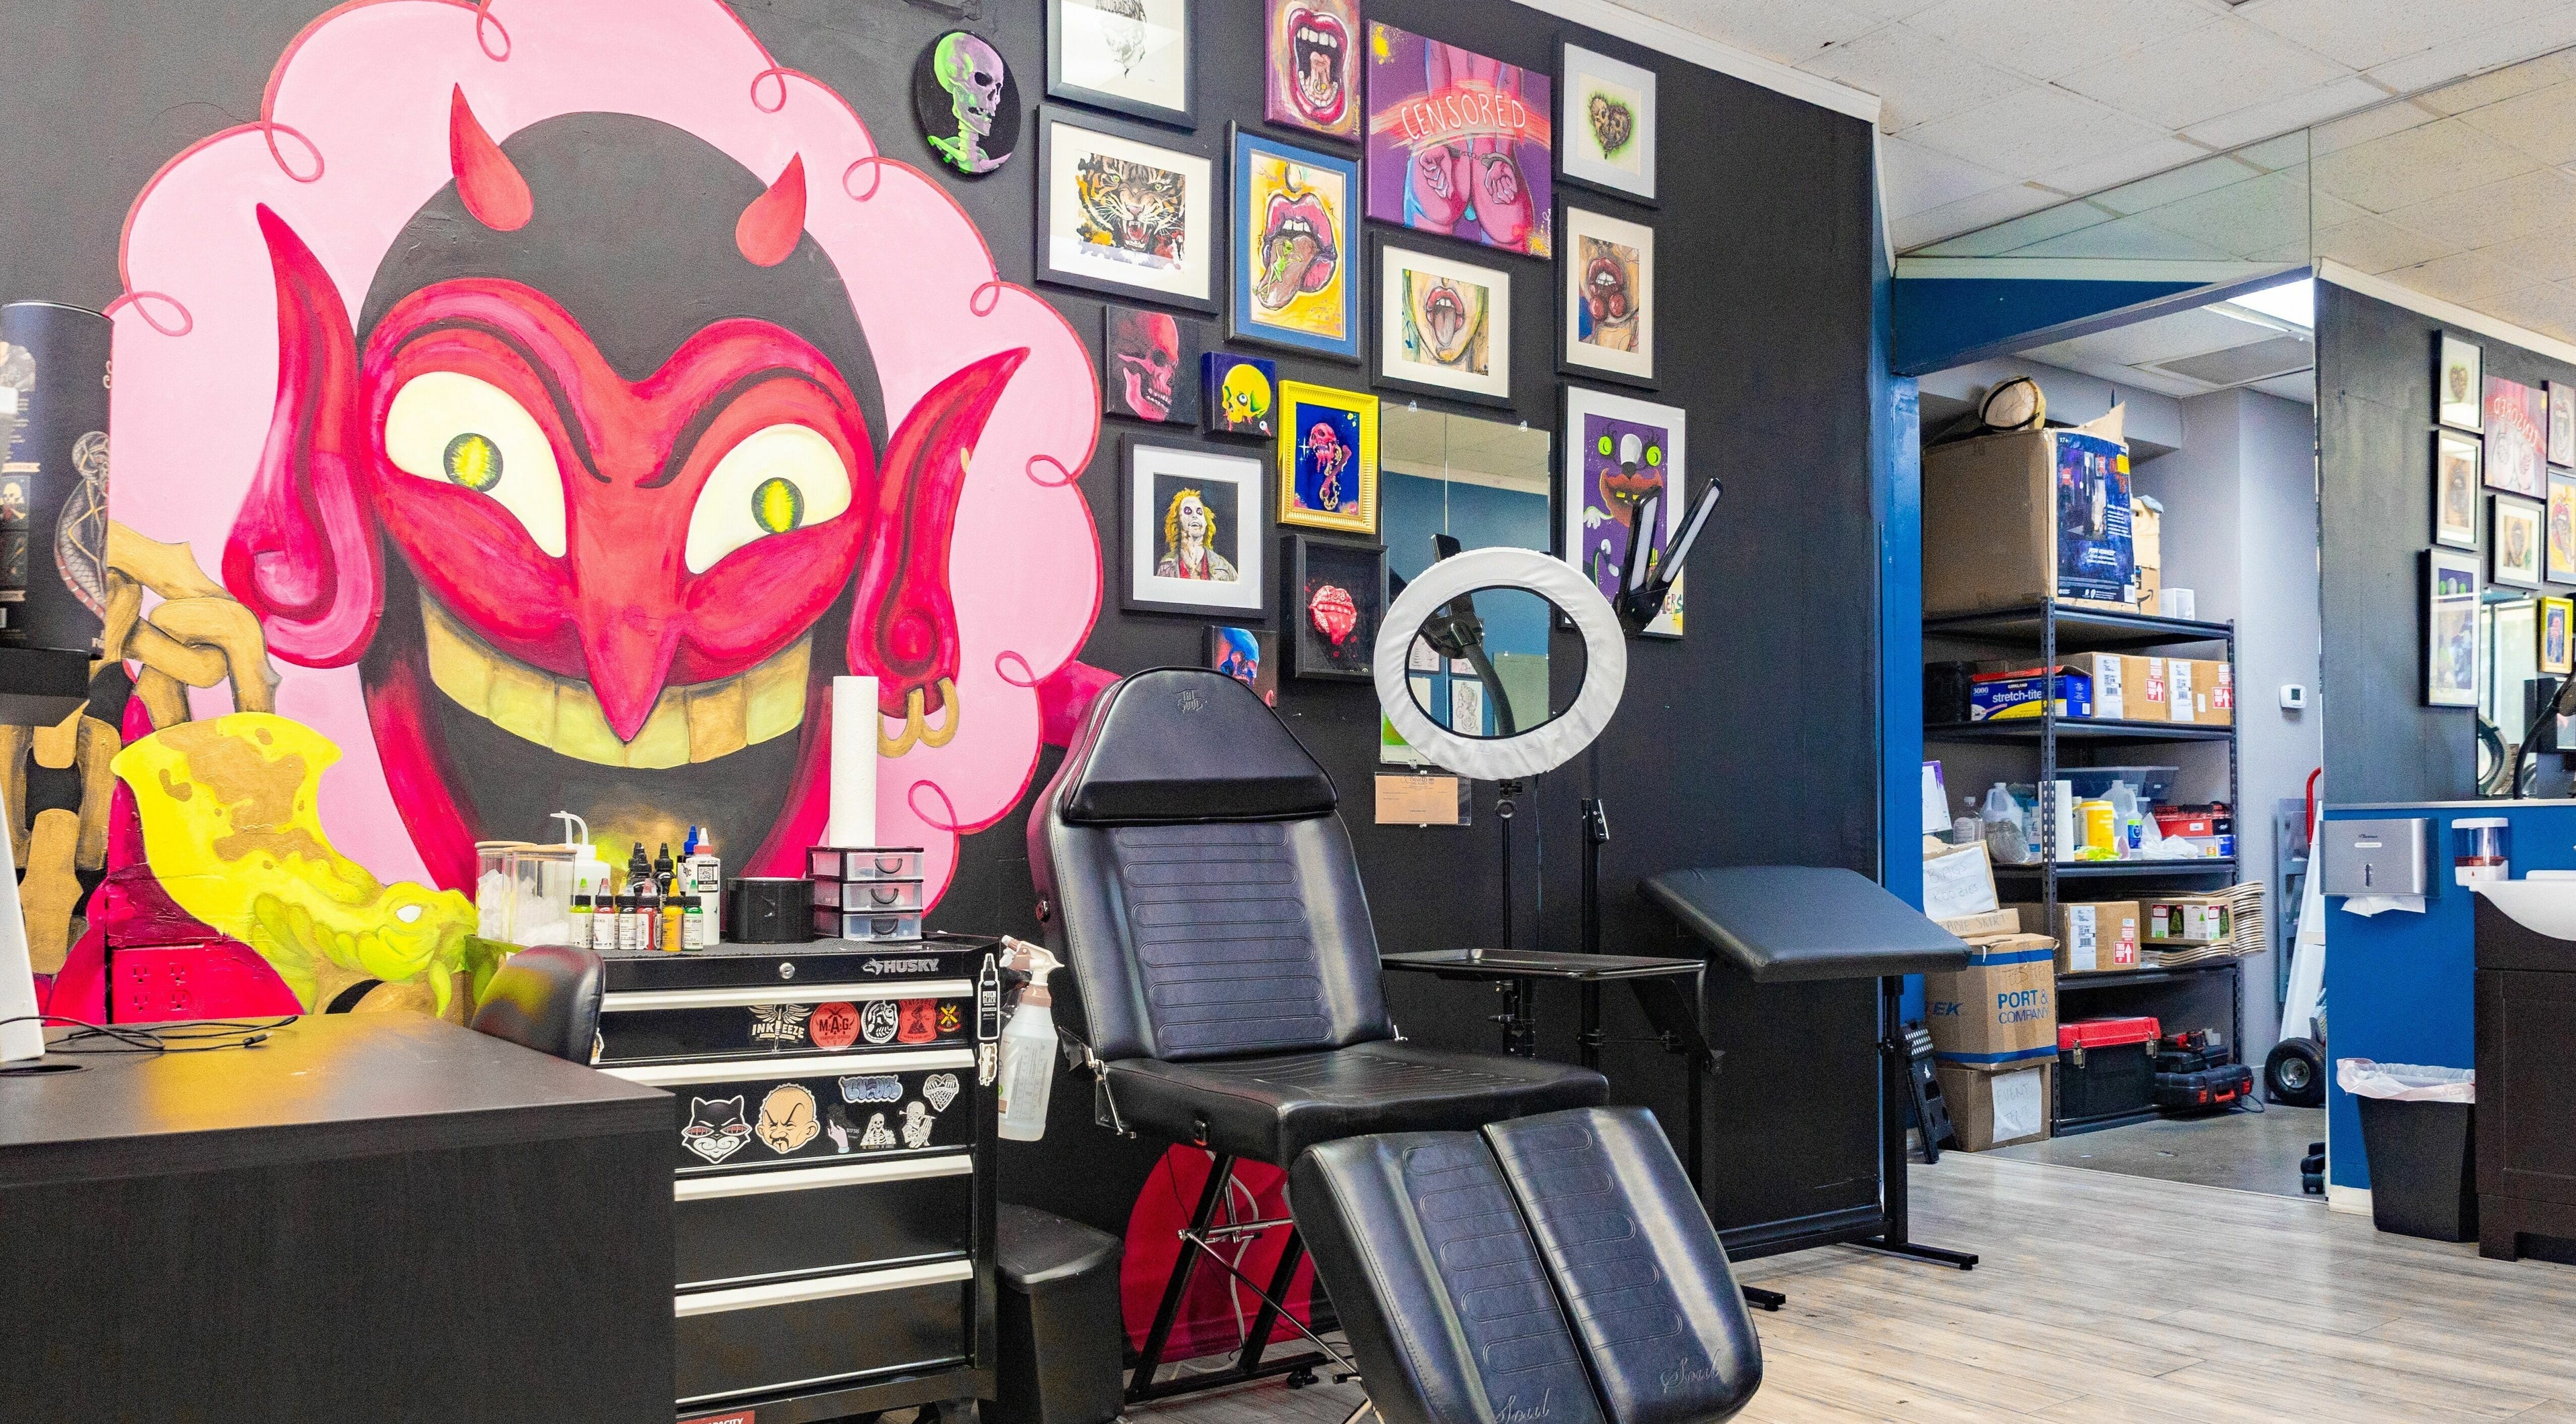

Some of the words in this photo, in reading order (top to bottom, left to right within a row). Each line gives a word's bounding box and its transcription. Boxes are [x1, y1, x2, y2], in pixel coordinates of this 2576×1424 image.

[1401, 93, 1526, 141] CENSORED
[1973, 687, 1988, 695] 3000
[1992, 690, 2042, 703] stretch-tite
[883, 959, 939, 973] HUSKY
[1998, 989, 2038, 1009] PORT
[2041, 989, 2048, 1004] &
[1998, 1007, 2050, 1024] COMPANY
